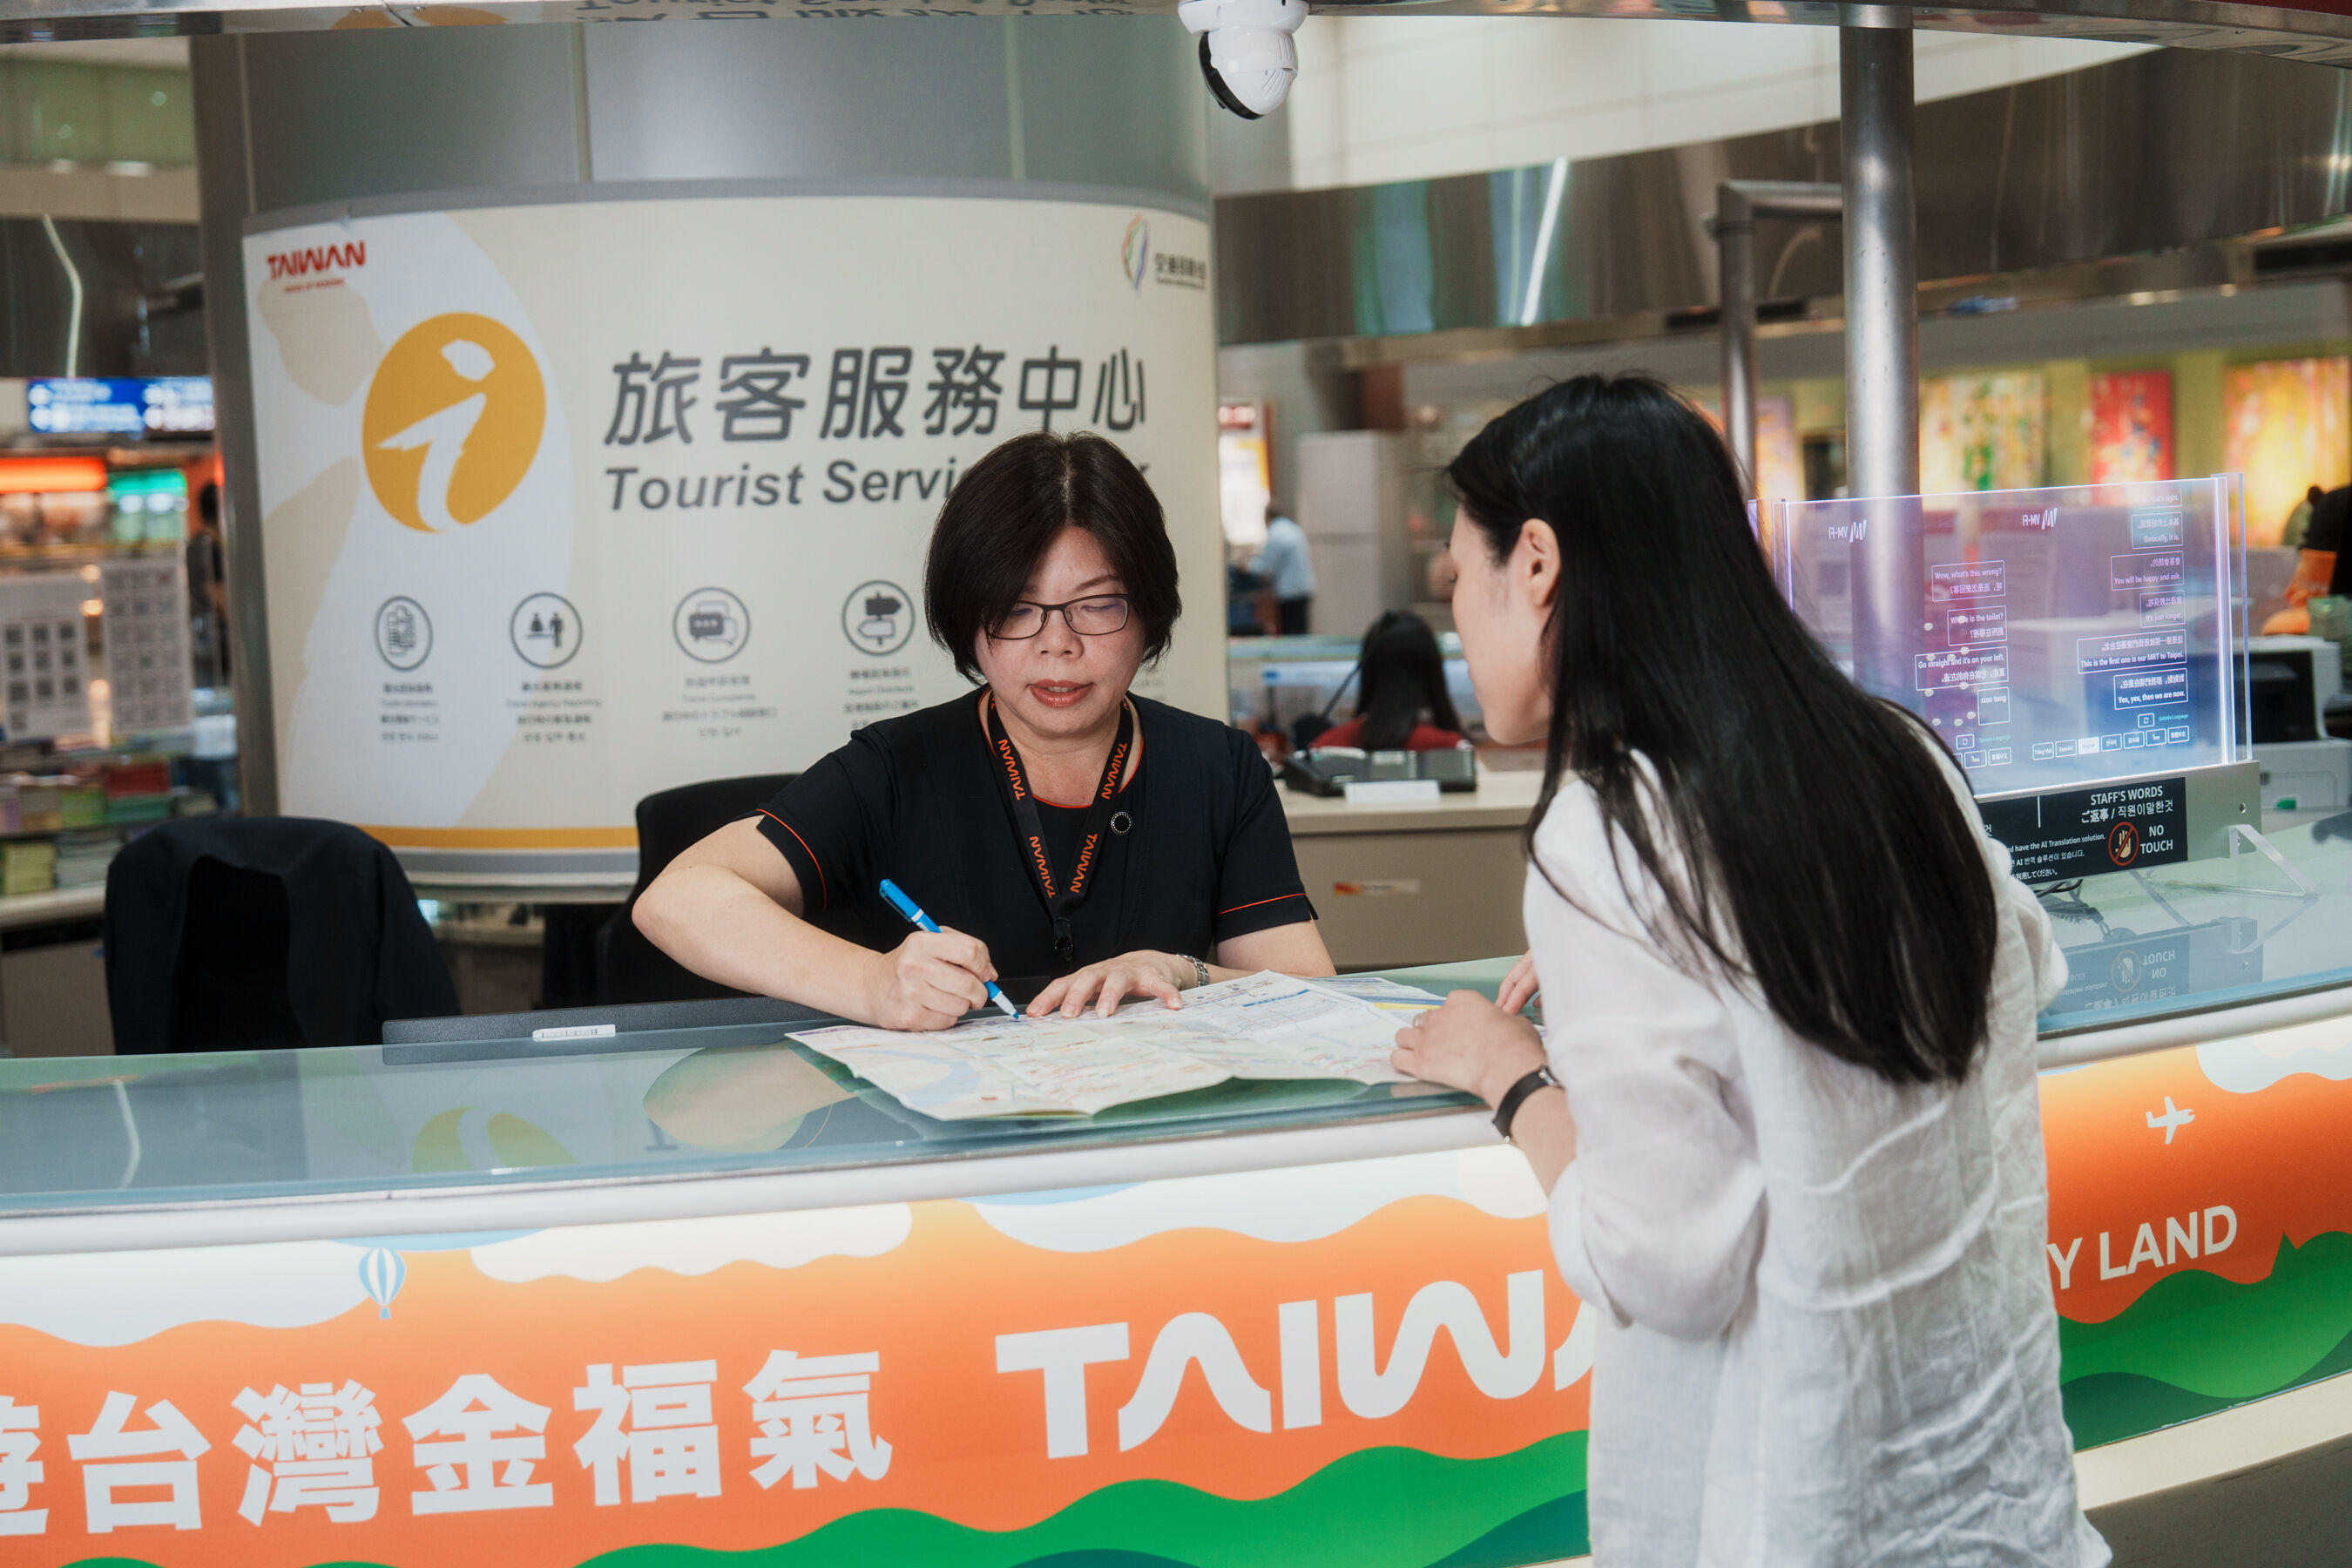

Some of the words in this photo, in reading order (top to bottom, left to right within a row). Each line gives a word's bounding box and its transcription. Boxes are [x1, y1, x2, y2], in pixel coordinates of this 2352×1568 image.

[267, 239, 366, 280] TAIWAN
[605, 341, 1146, 447] 旅客服務中心
[605, 466, 803, 510] Tourist
[824, 458, 963, 504] Servi
[2144, 534, 2167, 543] Basically,
[1935, 571, 1950, 581] Wow,
[1951, 570, 1969, 578] what's
[1982, 567, 2002, 578] wrong?
[1950, 615, 1969, 625] Whe
[1976, 613, 1986, 622] the
[1987, 612, 2004, 621] toilet?
[2165, 612, 2182, 621] longer.
[1928, 659, 1950, 669] straight
[1950, 657, 1962, 666] and
[1980, 656, 1992, 665] your
[1994, 653, 2005, 662] left.
[2166, 652, 2184, 660] Taipei.
[1993, 695, 2006, 704] tong
[2118, 696, 2130, 705] Yes,
[2131, 695, 2141, 704] yes,
[997, 739, 1026, 801] TAIWAN
[1101, 742, 1127, 800] TAIWAN
[2091, 790, 2126, 806] STAFF'S
[2127, 785, 2163, 801] WORDS
[2118, 799, 2173, 819] 직원이말한것
[2149, 824, 2164, 837] NO
[2031, 841, 2040, 849] the
[2049, 837, 2080, 848] Translation
[2081, 834, 2105, 842] solution.
[2140, 840, 2173, 855] TOUCH
[1029, 836, 1056, 899] TAIWAN
[1070, 833, 1098, 894] TAIWAN
[2099, 1204, 2238, 1281] LAND
[995, 1268, 1596, 1460] TAIW
